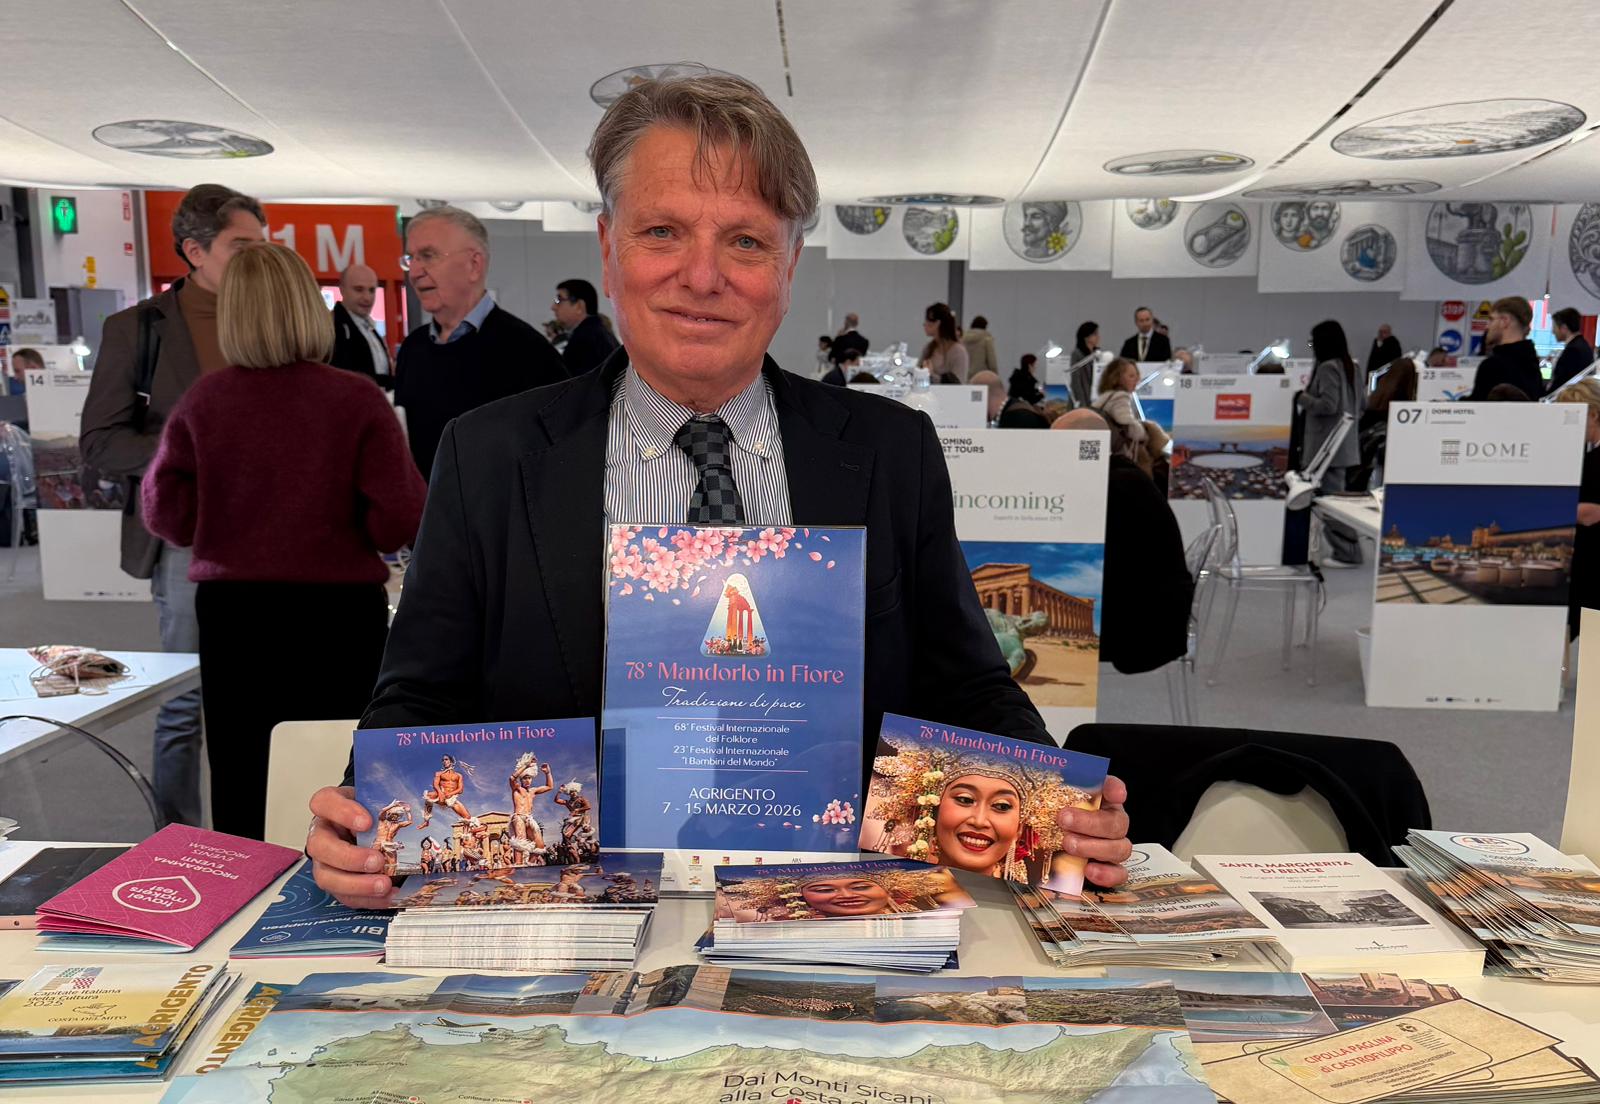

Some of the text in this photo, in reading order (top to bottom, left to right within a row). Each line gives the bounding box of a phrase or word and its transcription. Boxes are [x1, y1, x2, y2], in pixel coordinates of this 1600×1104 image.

[315, 224, 365, 272] M
[29, 374, 45, 386] 14
[1180, 378, 1192, 388] 18
[1396, 408, 1422, 425] 07
[939, 438, 973, 446] OMING
[1465, 442, 1532, 458] DOME
[953, 490, 1065, 514] incoming
[624, 661, 845, 684] 78° Mandorlo in Fiore
[661, 686, 806, 716] Tradizione di pace
[396, 726, 556, 747] 78° Mandorlo in Fiore
[690, 723, 725, 733] Festival
[726, 723, 790, 734] Internazionale
[705, 734, 758, 744] del Folklore
[690, 746, 725, 755] Festival
[726, 746, 789, 757] Internazionale
[941, 730, 1011, 756] Mandorlo
[1014, 745, 1028, 760] in
[1030, 748, 1068, 768] Fiore
[689, 757, 725, 766] Bambini
[727, 757, 741, 767] del
[688, 787, 776, 801] AGRIGENTO
[663, 802, 670, 814] 7
[687, 802, 702, 815] 15
[705, 803, 760, 816] MARZO
[765, 803, 801, 817] 2026
[189, 842, 250, 859] PROGRAM
[191, 849, 234, 862] EVENTS
[154, 856, 239, 880] PROGRAMMA
[180, 856, 225, 869] EVENTI
[777, 865, 844, 875] Mandorlo
[866, 861, 901, 869] Fiore
[1264, 860, 1354, 868] MARGHERITA
[1128, 872, 1181, 885] rigento
[129, 886, 188, 904] makers
[149, 885, 179, 896] fest
[127, 892, 174, 907] travel
[132, 964, 214, 1047] AGRIGENTO
[195, 985, 283, 1076] AGRIGENTO
[1304, 1046, 1351, 1063] CIPOLLA
[1348, 1035, 1397, 1053] PAGLINA
[1320, 1044, 1413, 1073] di CASTROFILIPPO
[719, 1086, 841, 1104] alla Costa
[723, 1071, 932, 1104] Dai Monti Sicani
